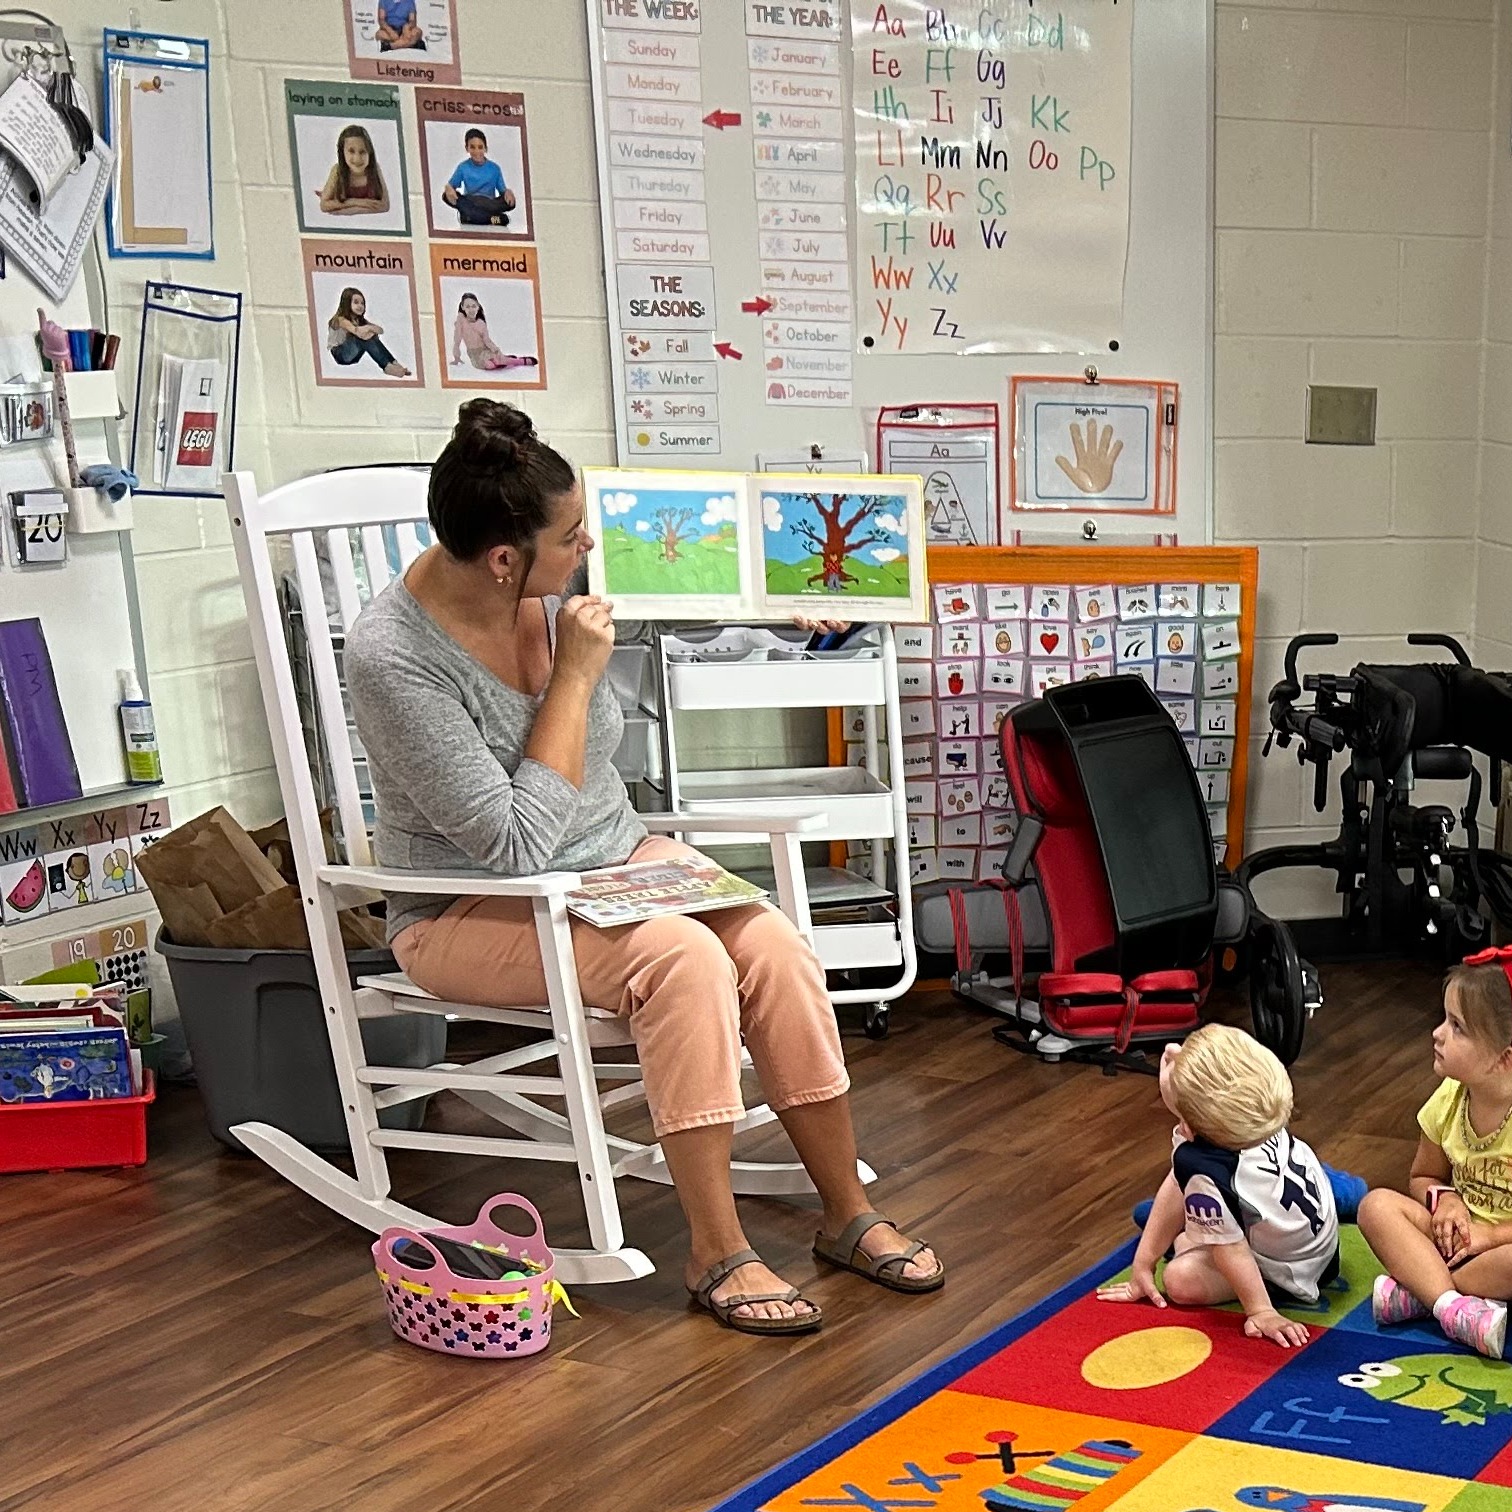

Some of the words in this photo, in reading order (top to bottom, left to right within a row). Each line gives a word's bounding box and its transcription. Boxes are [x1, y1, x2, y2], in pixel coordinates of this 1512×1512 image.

[752, 5, 785, 24] THE
[872, 4, 907, 39] Aa
[926, 9, 957, 42] Bb
[978, 9, 1006, 42] Cc
[1028, 13, 1063, 50] Dd
[628, 40, 677, 59] Sunday
[771, 47, 826, 66] January
[377, 62, 435, 81] Listening
[872, 49, 902, 78] Ee
[926, 48, 957, 83] Ff
[977, 50, 1006, 89] Gg
[627, 73, 680, 94] Monday
[772, 80, 834, 100] February
[288, 91, 325, 107] laying
[328, 94, 343, 105] on
[347, 94, 399, 108] stomach
[423, 99, 466, 114] criss
[874, 85, 910, 120] Hh
[930, 89, 953, 124] Ii
[980, 96, 1003, 129] Jj
[1031, 94, 1071, 133] Kk
[629, 108, 684, 129] Tuesday
[780, 114, 821, 129] March
[618, 142, 696, 164] Wednesday
[787, 149, 817, 164] April
[877, 129, 904, 168] Ll
[921, 135, 961, 170] Mm
[976, 140, 1008, 172] Nn
[1028, 139, 1059, 170] Oo
[1080, 146, 1116, 191] Pp
[628, 176, 690, 195] Thursday
[789, 181, 816, 195] May
[874, 174, 917, 215] Qq
[926, 173, 966, 213] Rr
[977, 178, 1007, 215] Ss
[639, 207, 683, 225] Friday
[789, 208, 820, 224] June
[874, 220, 916, 255] Tt
[930, 221, 956, 249] Uu
[980, 218, 1007, 250] Vv
[632, 237, 694, 256] Saturday
[792, 239, 820, 256] July
[315, 250, 403, 270] mountain
[443, 254, 528, 273] mermaid
[650, 275, 682, 293] THE
[790, 269, 833, 286] August
[871, 255, 914, 290] Ww
[928, 259, 959, 295] Xx
[629, 299, 706, 318] SEASONS:
[779, 298, 848, 314] September
[876, 297, 908, 350] Yy
[929, 308, 966, 339] Zz
[786, 326, 839, 342] October
[666, 339, 689, 353] Fall
[786, 357, 848, 372] November
[658, 371, 705, 385] Winter
[787, 386, 850, 400] December
[664, 401, 705, 417] Spring
[182, 429, 213, 451] LEGO
[659, 431, 713, 446] Summer
[930, 444, 950, 458] Aa
[27, 512, 64, 544] 20
[1167, 624, 1185, 632] good
[904, 638, 922, 647] and
[904, 676, 920, 685] are
[952, 705, 968, 713] help
[910, 715, 919, 723] is
[136, 803, 162, 831] Zz
[50, 820, 76, 849] Xx
[93, 812, 117, 844] Yy
[956, 827, 966, 836] to
[0, 831, 37, 862] Ww
[946, 859, 965, 868] with
[112, 926, 136, 951] 20
[1250, 1395, 1391, 1445] Ff
